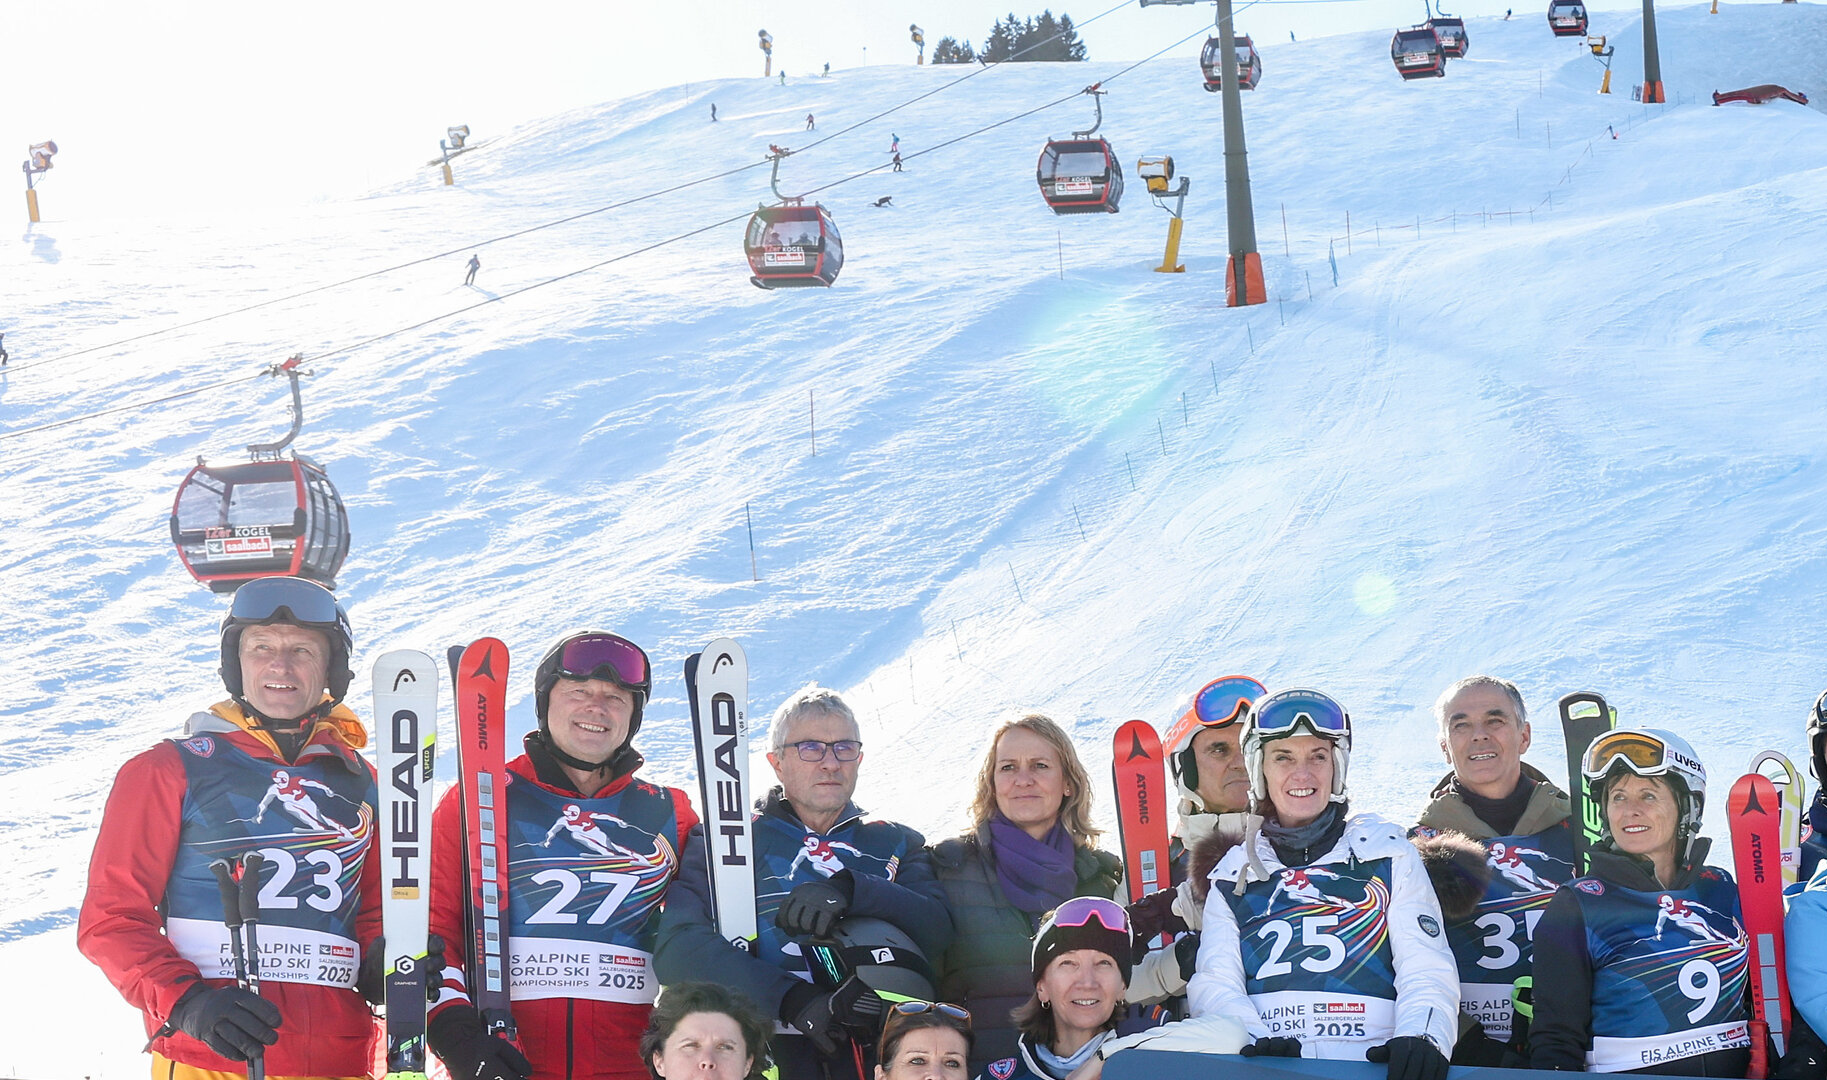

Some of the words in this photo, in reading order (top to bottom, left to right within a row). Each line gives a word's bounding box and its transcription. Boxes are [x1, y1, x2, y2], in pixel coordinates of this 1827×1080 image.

[235, 527, 271, 538] KOGEL
[226, 539, 268, 552] saalbach
[477, 693, 488, 750] ATOMIC
[1674, 751, 1702, 773] uvex
[711, 692, 746, 865] HEAD
[392, 709, 419, 888] HEAD
[1136, 773, 1150, 825] ATOMIC
[1751, 833, 1765, 885] ATOMIC
[257, 847, 344, 913] 23
[525, 868, 640, 926] 27
[1255, 914, 1347, 981] 25
[287, 957, 311, 969] SKI
[526, 954, 591, 964] ALPINE
[317, 965, 352, 983] 2025
[511, 966, 558, 977] ORLD
[564, 966, 589, 977] SKI
[598, 973, 645, 990] 2025
[1677, 958, 1721, 1024] 9
[1261, 1004, 1306, 1021] ALPINE
[1329, 1002, 1363, 1013] saalbach
[1285, 1018, 1306, 1031] SKI
[1474, 1012, 1510, 1022] ORLD
[1313, 1023, 1366, 1037] 2025
[1666, 1036, 1715, 1056] ALPINE
